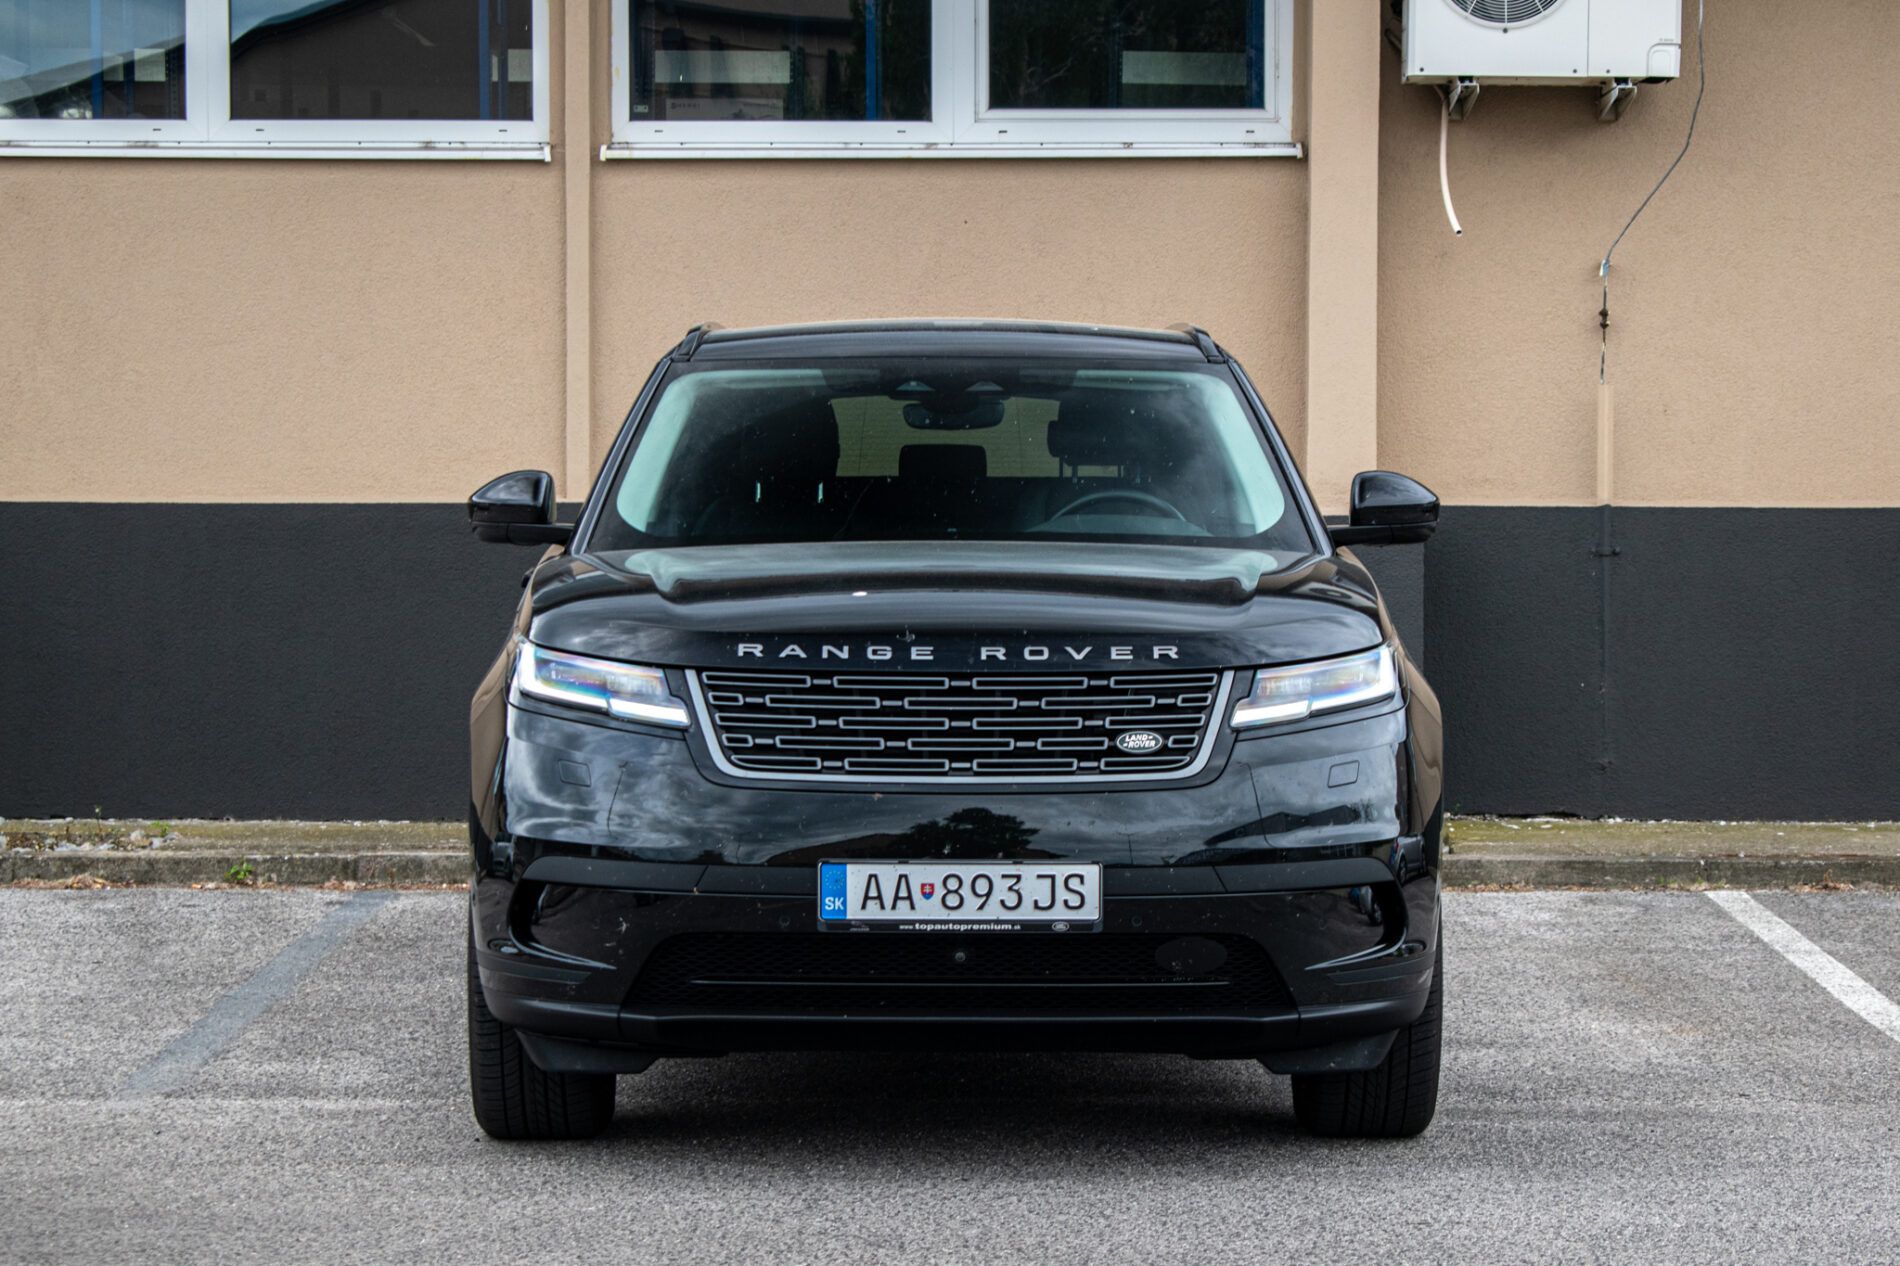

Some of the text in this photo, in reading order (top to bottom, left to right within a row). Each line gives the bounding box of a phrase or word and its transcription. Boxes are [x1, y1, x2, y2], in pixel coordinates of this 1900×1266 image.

[737, 643, 1179, 660] RANGE ROVER
[860, 873, 1086, 911] AA 893JS
[824, 896, 844, 910] SK
